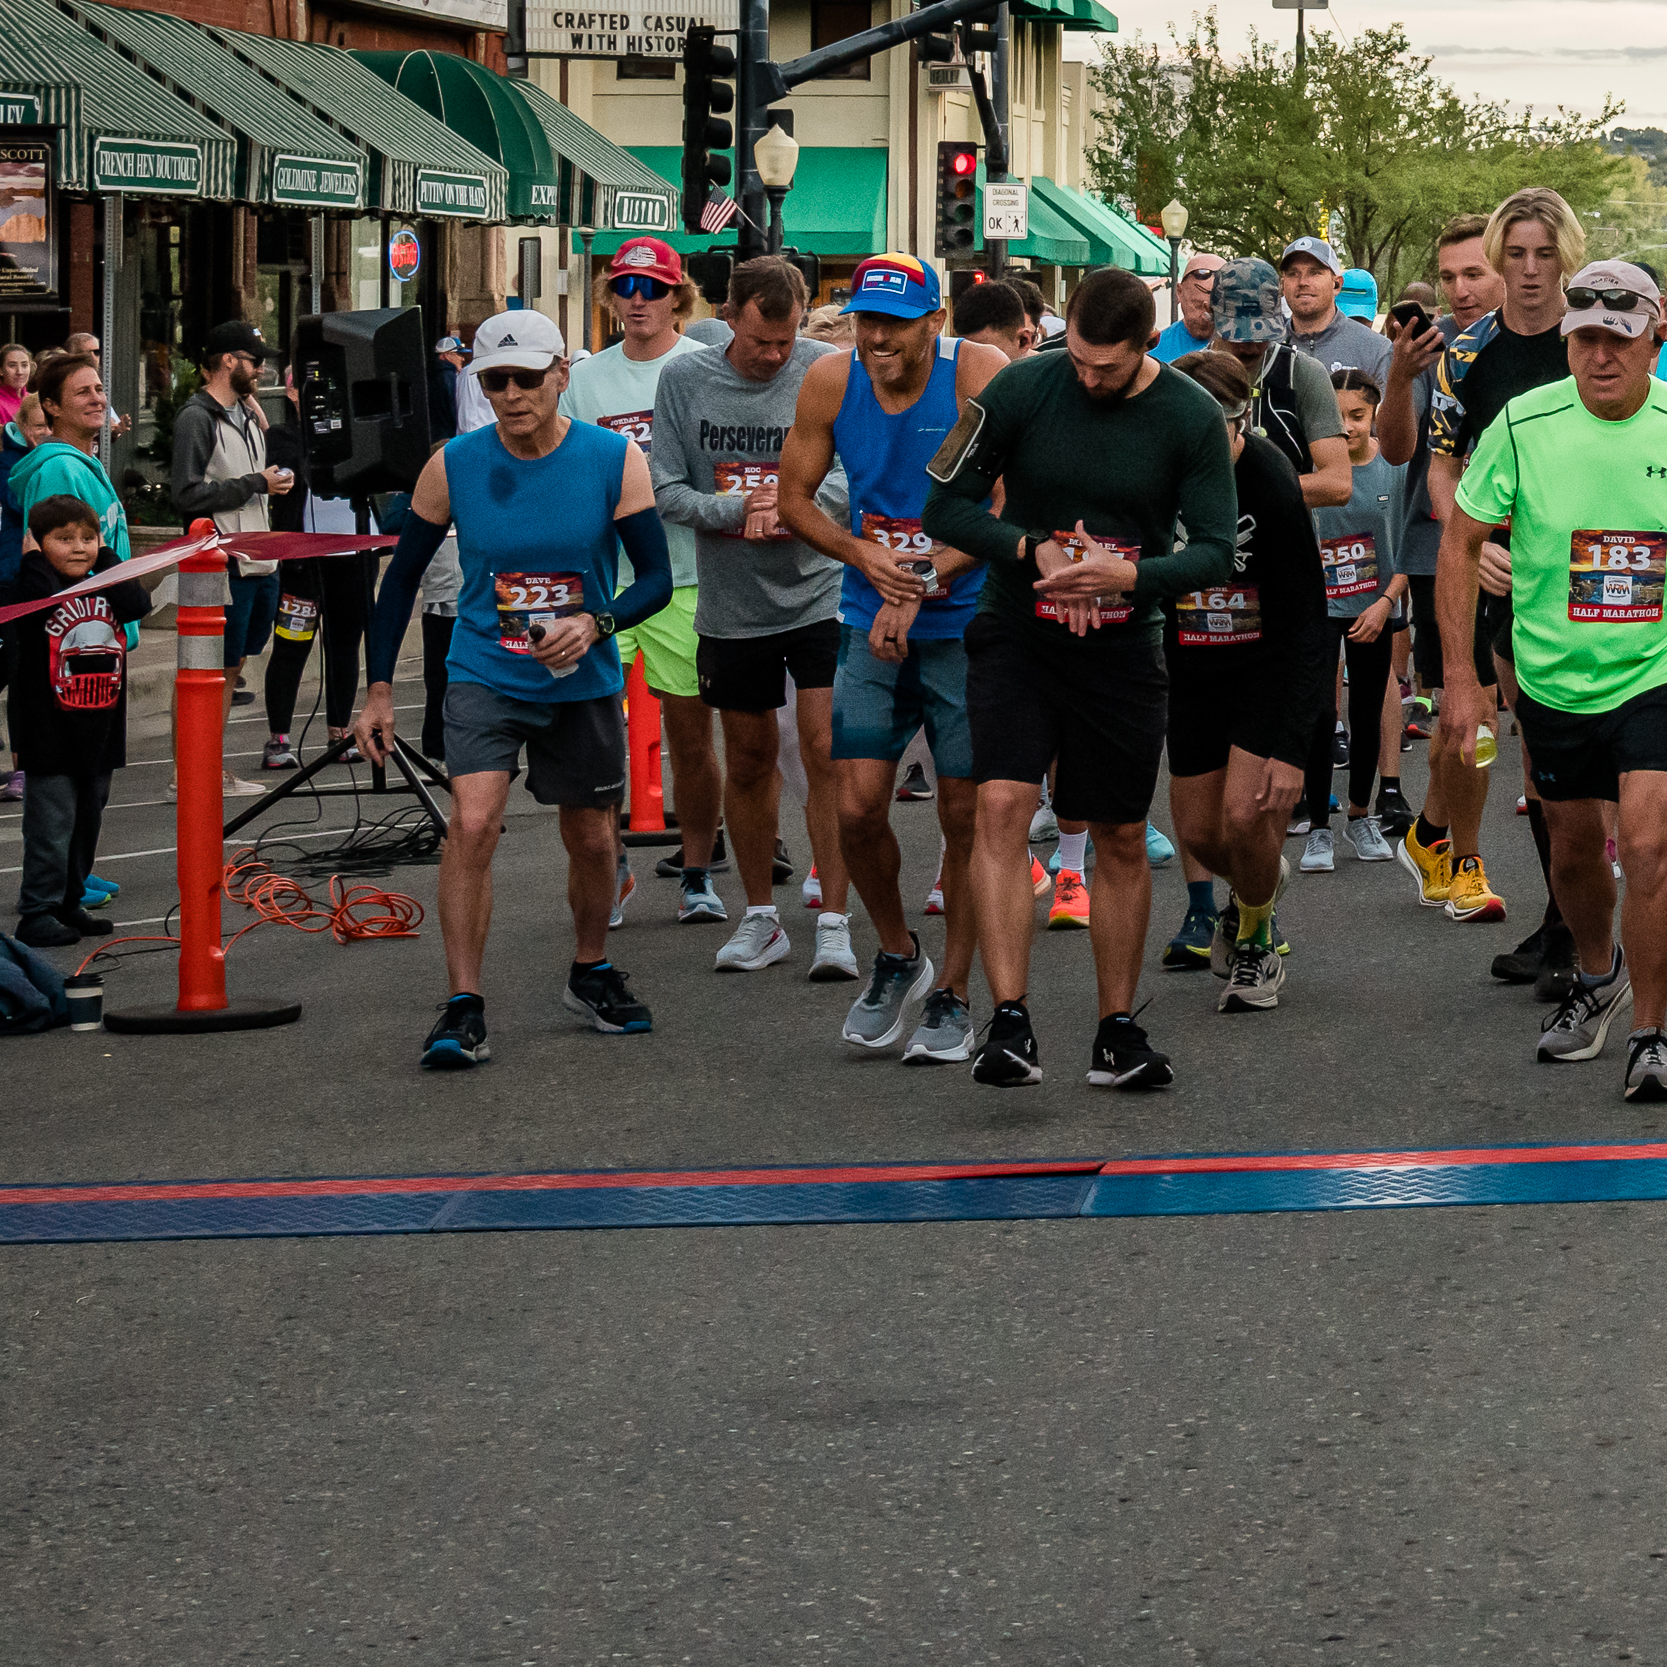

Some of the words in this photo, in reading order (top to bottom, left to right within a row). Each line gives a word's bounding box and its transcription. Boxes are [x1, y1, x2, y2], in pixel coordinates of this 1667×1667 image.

[553, 12, 630, 31] CRAFTED
[571, 32, 617, 51] WITH
[100, 150, 135, 178] FRENCH
[136, 153, 154, 179] HEN
[156, 154, 198, 181] BOUTIQUE
[278, 167, 317, 192] GOLDMINE
[319, 171, 357, 196] JEWELERS
[445, 183, 455, 204] ON
[454, 184, 468, 206] THE
[468, 185, 485, 208] HATS
[992, 188, 1019, 196] DIAGONAL
[622, 198, 660, 224] BISTRO
[988, 217, 1003, 230] OK
[610, 416, 640, 426] JORDAN
[873, 529, 933, 555] 329
[1602, 535, 1636, 544] DAVID
[1321, 543, 1366, 565] 350
[1587, 544, 1651, 571] 183
[525, 577, 551, 585] DAVE
[1340, 581, 1378, 594] MARATHON
[509, 584, 570, 609] 223
[1190, 591, 1247, 610] 164
[1572, 607, 1600, 617] HALF
[1602, 607, 1659, 618] MARATHON
[1184, 633, 1208, 642] HALF
[1209, 632, 1260, 642] MARATHON
